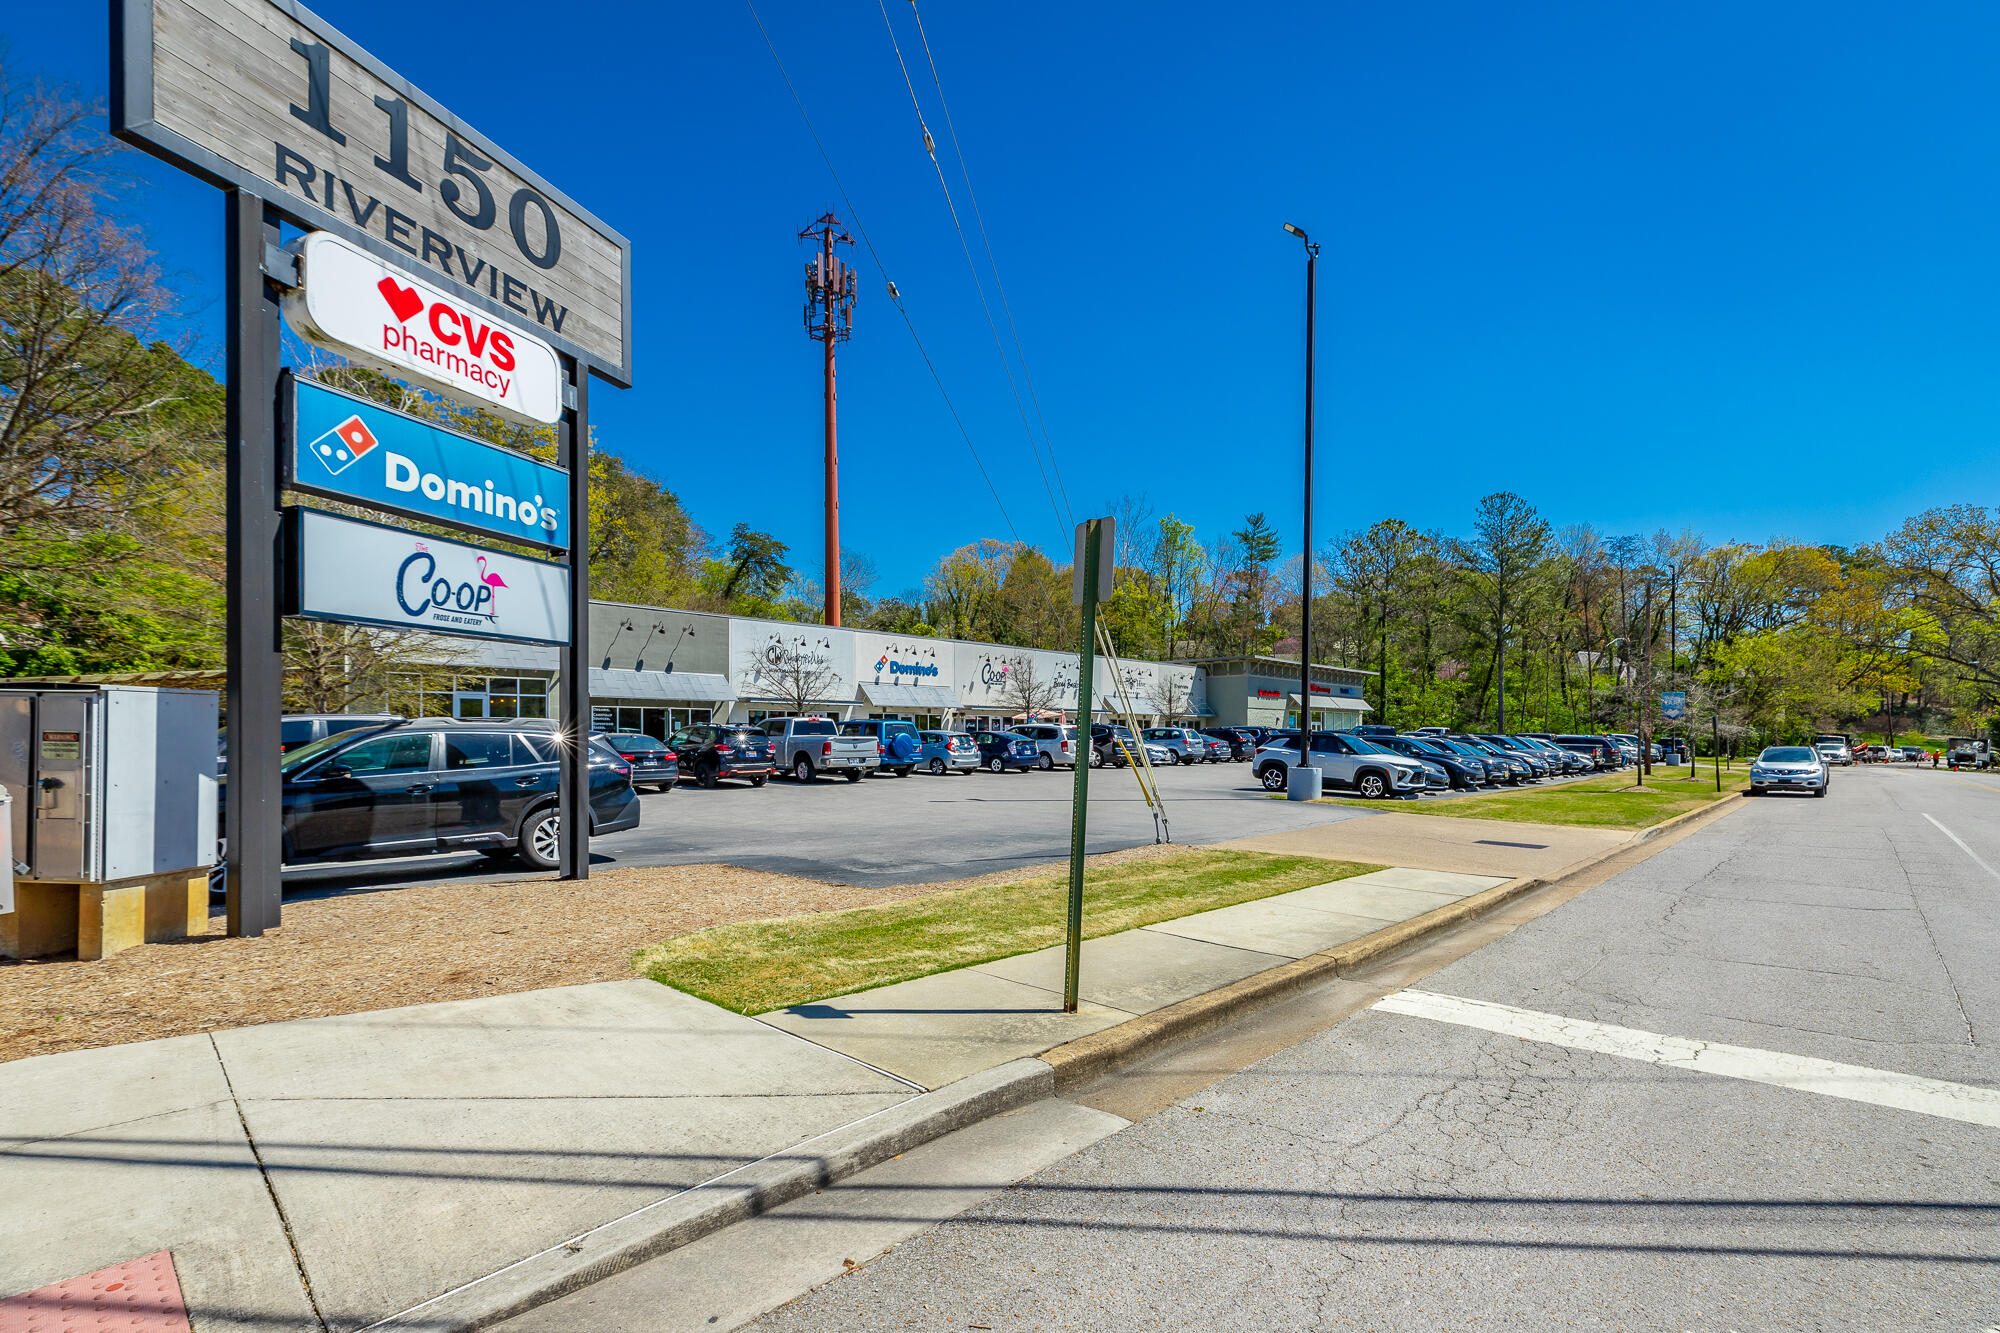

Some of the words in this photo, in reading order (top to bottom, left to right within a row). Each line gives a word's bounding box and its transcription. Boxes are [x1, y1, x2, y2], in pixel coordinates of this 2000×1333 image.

[289, 37, 561, 270] 1150
[275, 141, 569, 333] RIVERVIEW
[383, 322, 511, 398] pharmacy
[427, 301, 516, 372] CVS
[386, 450, 558, 531] Domino's
[397, 552, 492, 617] CO-OP
[433, 613, 450, 622] FROSE
[451, 615, 463, 624] AND
[464, 617, 483, 626] EATERY
[889, 660, 939, 677] Domino's
